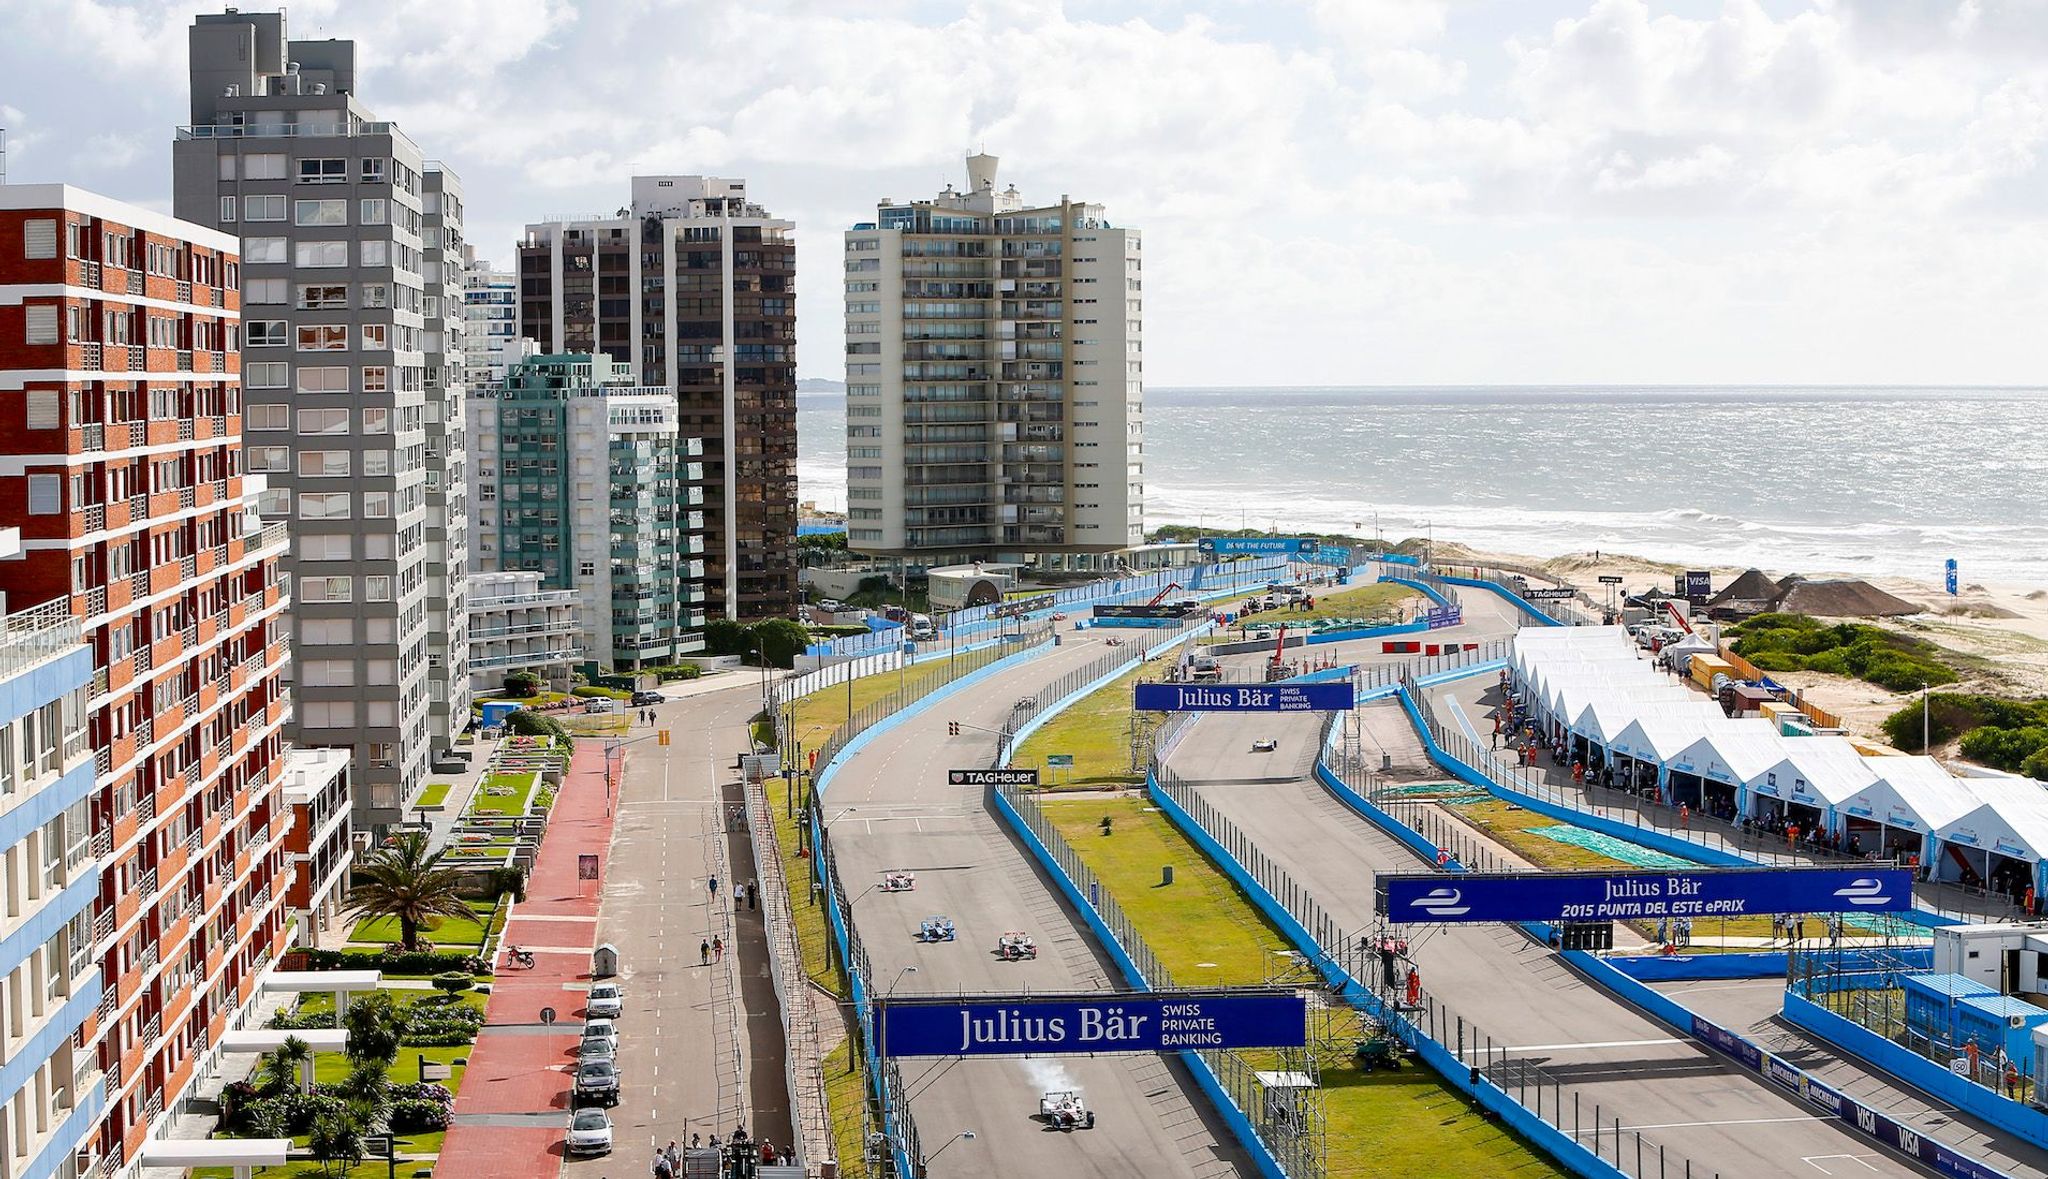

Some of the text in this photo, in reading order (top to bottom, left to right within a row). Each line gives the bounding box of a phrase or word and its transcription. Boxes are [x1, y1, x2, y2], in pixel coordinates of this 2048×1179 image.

[1689, 577, 1710, 586] VISA
[1178, 687, 1274, 710] Julius Bär
[1280, 702, 1311, 710] BANKING
[1605, 878, 1702, 901] Julius Bär
[1561, 899, 1745, 917] 2015 PUNTA DEL ESTE ePRIX
[1162, 1004, 1200, 1017] SWISS
[960, 1007, 1148, 1050] Julius Bär
[1162, 1018, 1215, 1031] PRIVATE
[1162, 1032, 1222, 1046] BANKING
[1772, 1062, 1799, 1086] MICHELIN
[1810, 1084, 1840, 1109] MICHELIN
[1855, 1104, 1876, 1135] VISA
[1897, 1125, 1921, 1158] VISA
